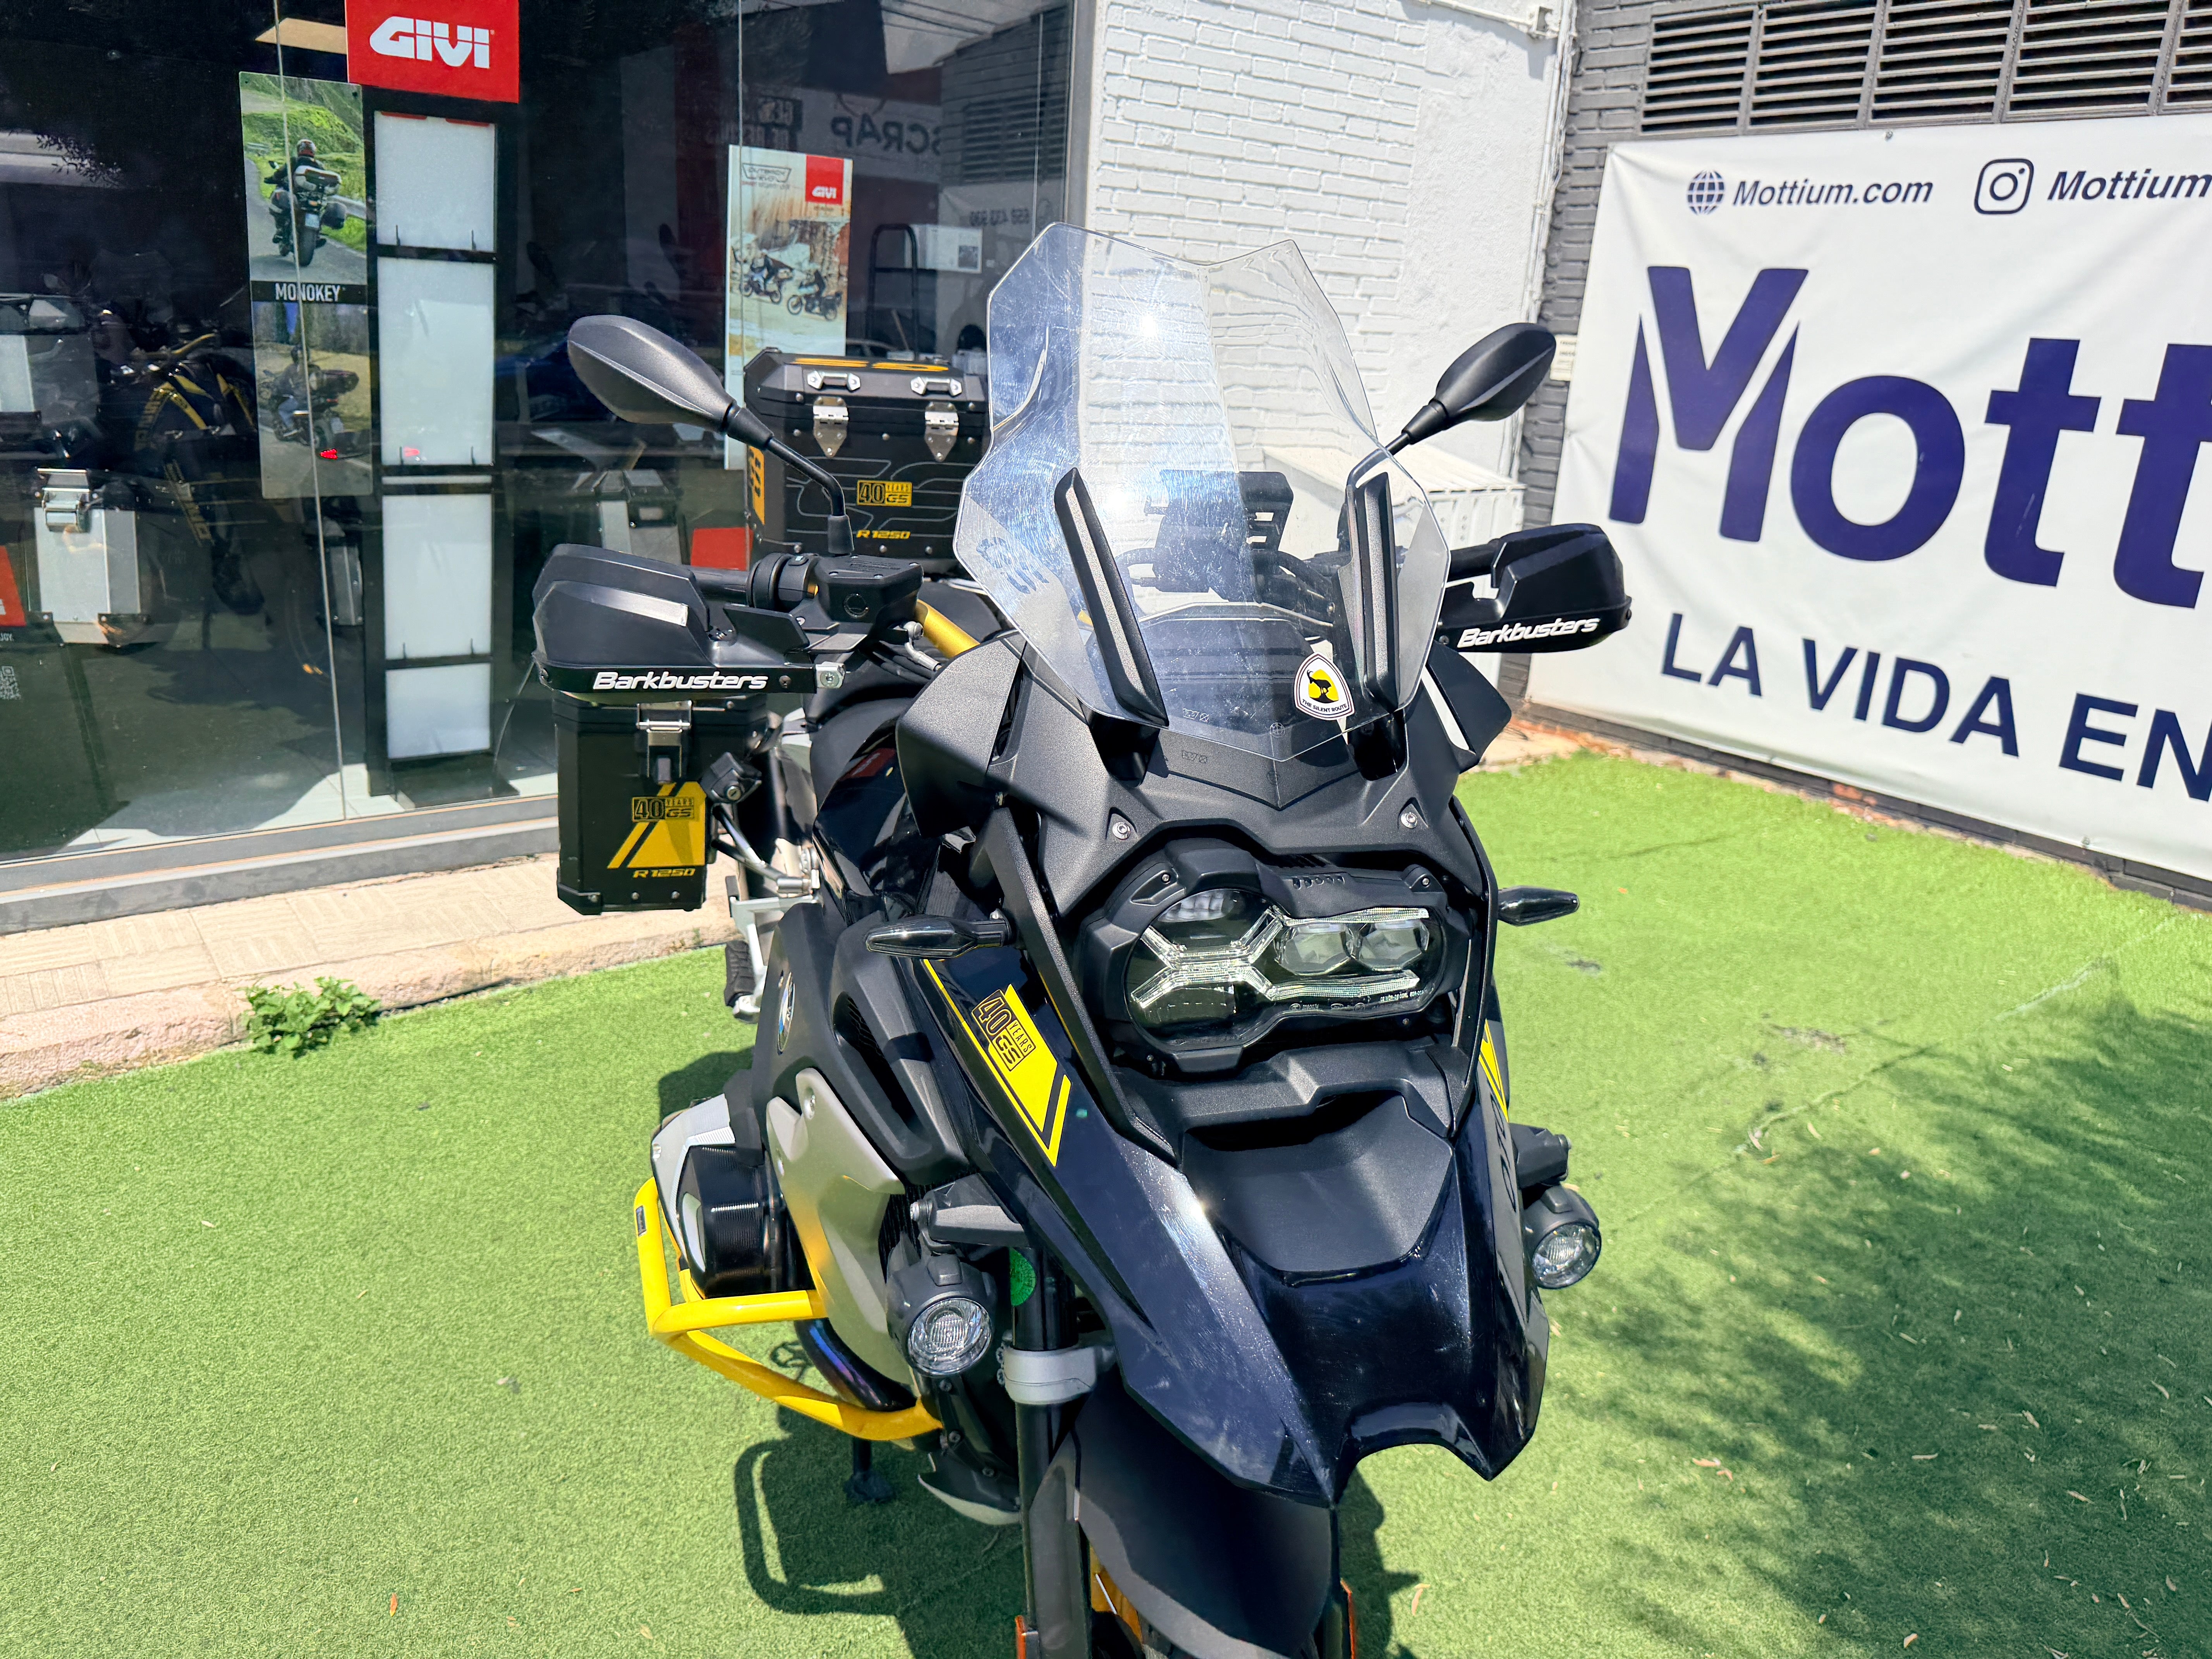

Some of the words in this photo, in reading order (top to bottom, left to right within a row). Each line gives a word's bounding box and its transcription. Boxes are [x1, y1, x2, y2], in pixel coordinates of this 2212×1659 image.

[369, 16, 490, 69] GIVI
[812, 186, 837, 199] GIVI
[1733, 176, 1933, 207] Mottium.com
[2047, 168, 2212, 200] Mottium
[275, 283, 341, 302] MONOKEY
[1609, 266, 2212, 609] Mott
[860, 483, 885, 503] 40
[887, 494, 908, 503] GS
[857, 530, 871, 538] R
[872, 531, 911, 539] 1250
[1457, 618, 1601, 648] Barkbusters
[592, 671, 768, 690] Barkbusters
[1302, 699, 1312, 708] THE
[1312, 704, 1330, 713] SILENT
[1331, 704, 1347, 712] ROUTE
[1661, 613, 1762, 697] LA
[1801, 637, 2019, 757] VIDA
[2059, 692, 2212, 803] EN
[635, 799, 665, 819] 40
[666, 809, 692, 818] GS
[633, 870, 649, 878] R
[651, 868, 696, 877] 1250
[978, 997, 1012, 1036] 40
[1009, 1022, 1032, 1053] YEARS
[996, 1035, 1021, 1064] GS
